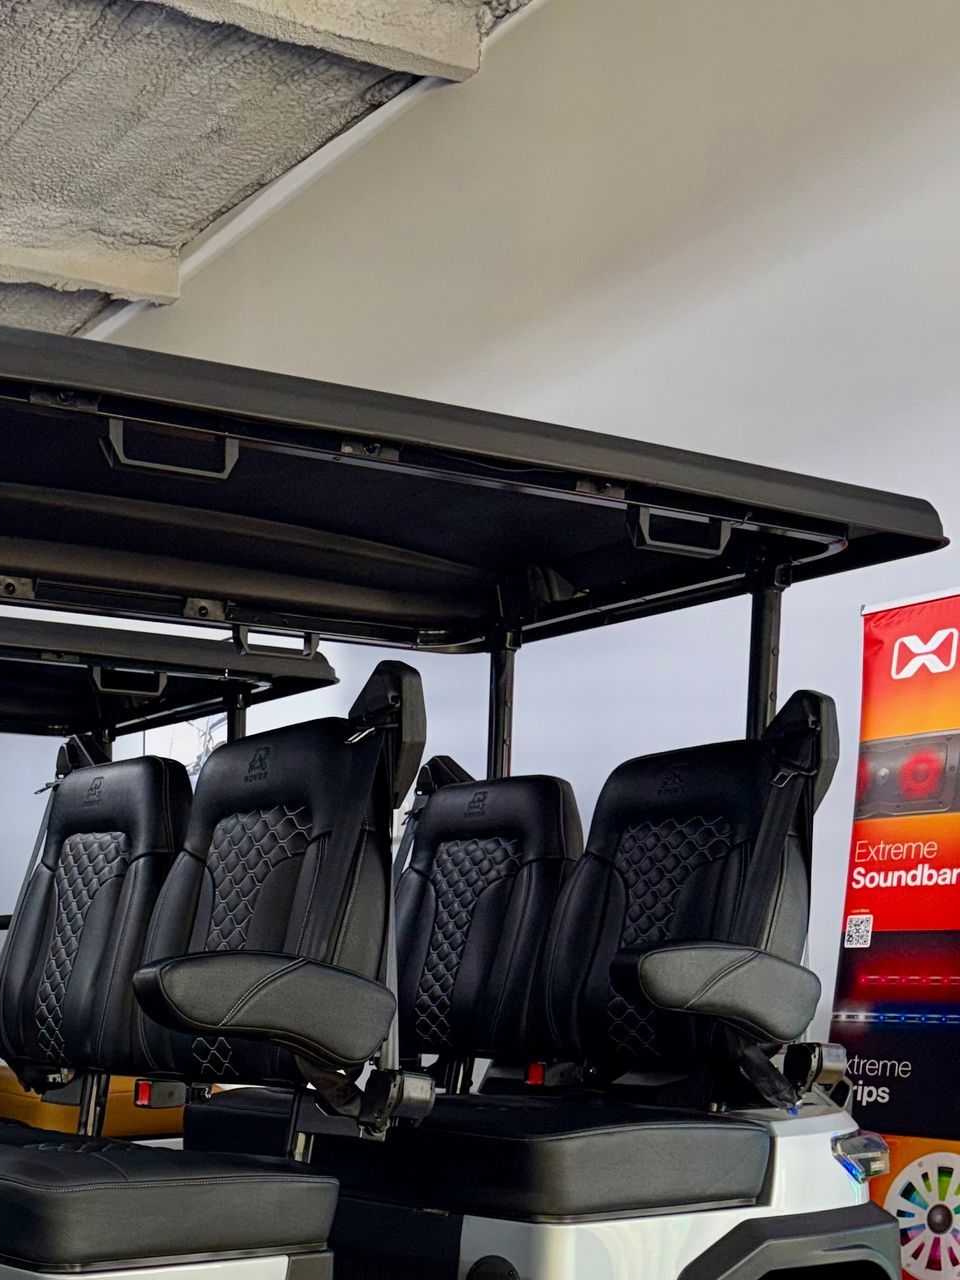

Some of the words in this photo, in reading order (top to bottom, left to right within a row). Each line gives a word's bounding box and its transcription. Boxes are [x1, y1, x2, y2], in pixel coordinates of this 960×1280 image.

[855, 840, 938, 862] Extreme
[851, 864, 960, 889] Soundbar
[847, 1054, 912, 1078] xtreme
